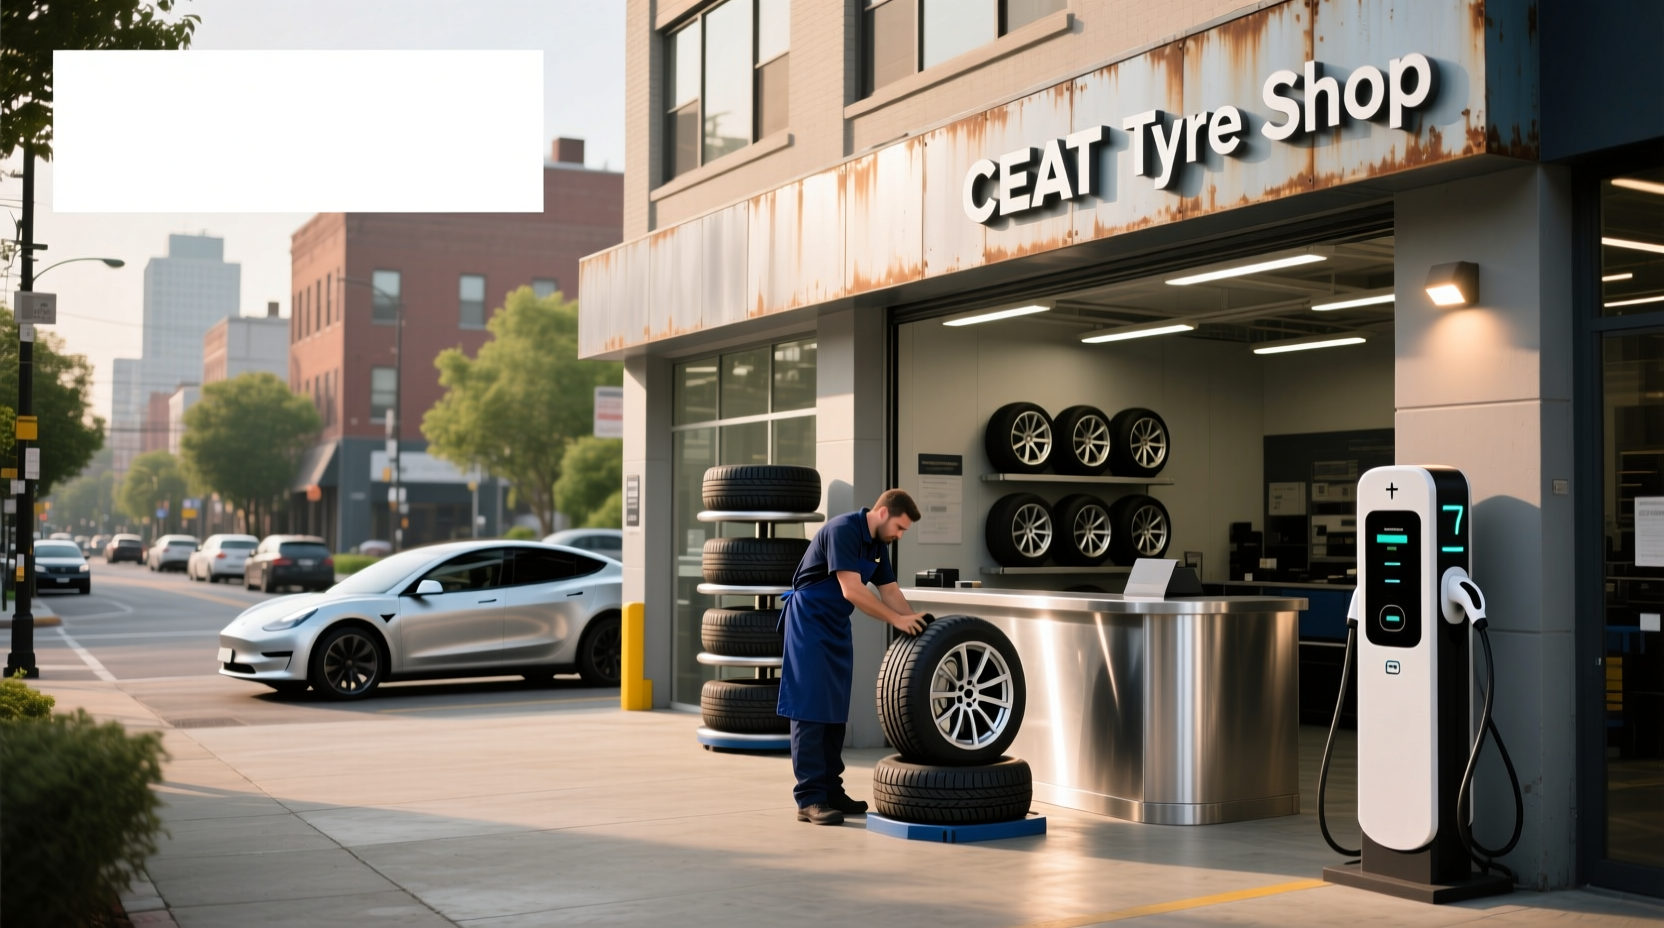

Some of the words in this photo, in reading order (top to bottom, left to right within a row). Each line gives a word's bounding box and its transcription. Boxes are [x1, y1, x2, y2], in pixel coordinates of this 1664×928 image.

[962, 125, 1105, 224] CEAT
[1123, 105, 1243, 191] Tyre
[1261, 53, 1432, 141] Shop
[1441, 504, 1464, 535] 7
